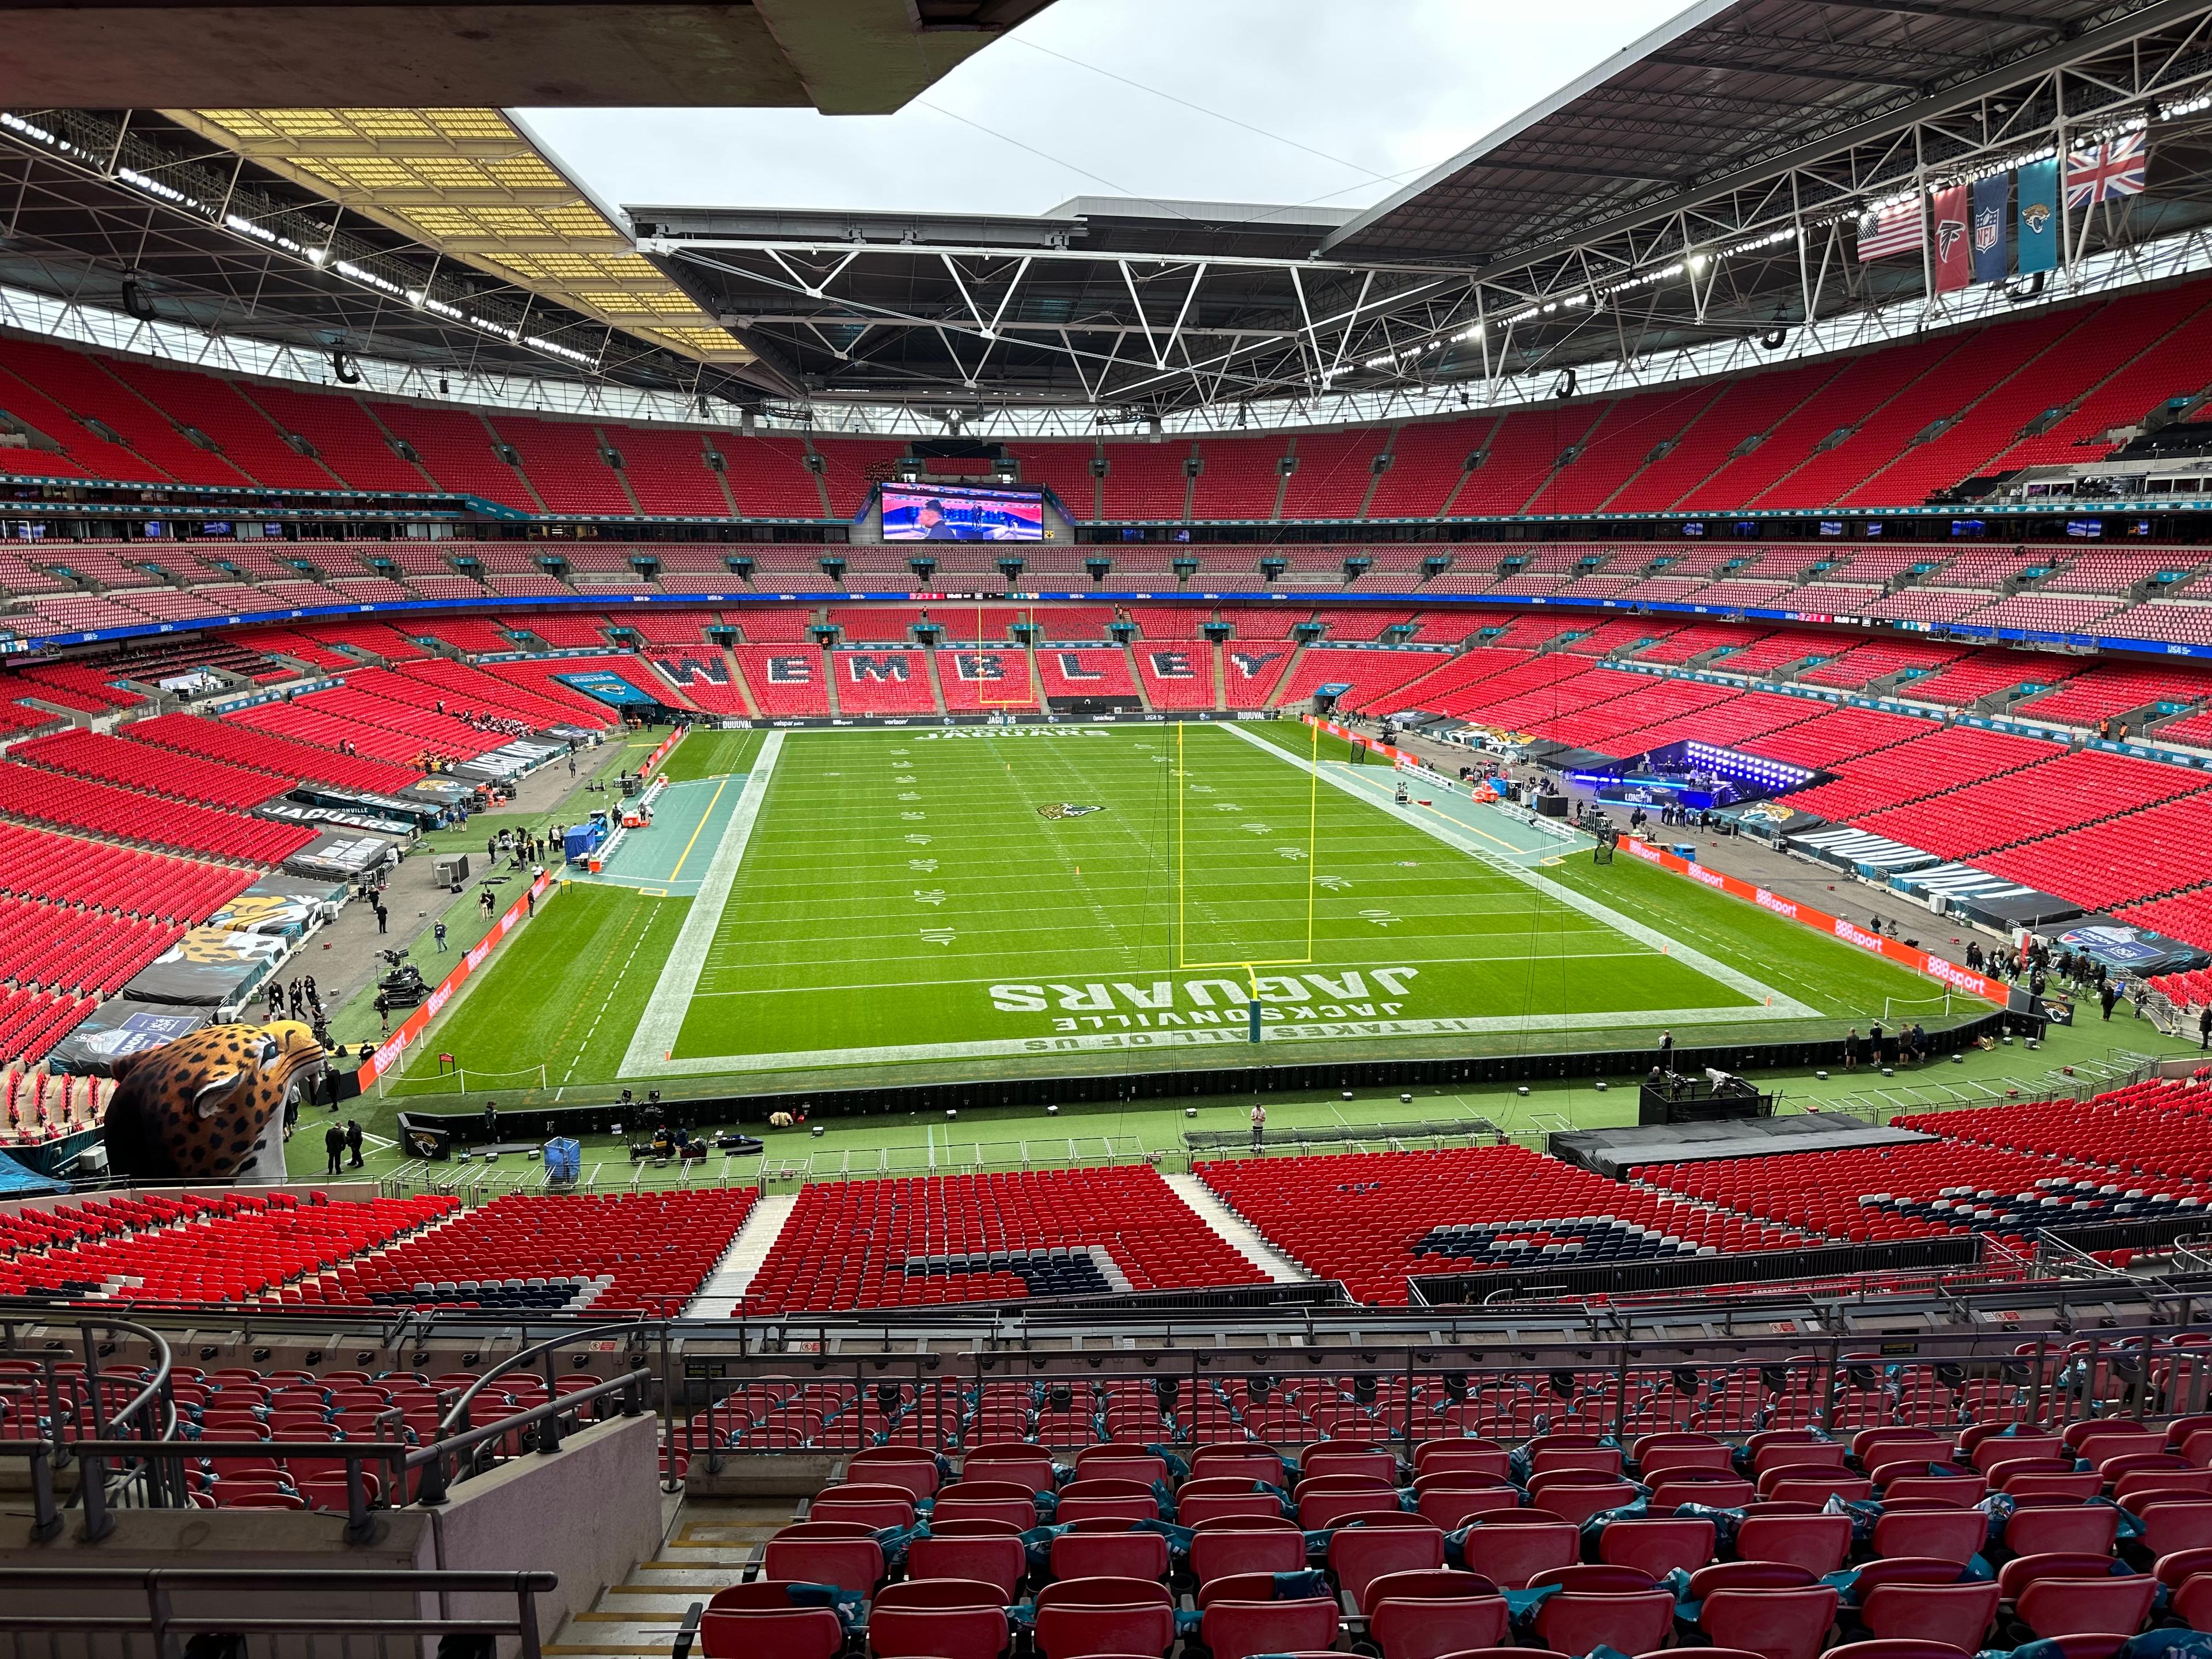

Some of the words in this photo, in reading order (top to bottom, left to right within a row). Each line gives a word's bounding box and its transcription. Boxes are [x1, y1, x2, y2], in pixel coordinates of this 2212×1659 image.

[1977, 226, 1994, 246] NFL
[653, 653, 1285, 689] WEMBLEY
[987, 716, 1016, 724] JAGURS
[1237, 711, 1265, 719] DUUUVAL
[722, 720, 752, 729] DUUUVAL
[914, 730, 1111, 740] JAGUARS
[1624, 793, 1652, 804] LONDN
[262, 808, 404, 831] JAGUARS
[900, 812, 926, 820] 50
[1241, 823, 1272, 832] 40
[904, 834, 932, 843] 40
[1274, 847, 1309, 858] 30
[1630, 839, 1661, 863] 888sport
[908, 859, 938, 870] 30
[1467, 849, 1530, 873] LONDON
[1312, 876, 1353, 888] 20
[1688, 862, 1724, 888] 888sport
[914, 889, 946, 903] 20
[1756, 888, 1797, 918] 888sport
[1358, 910, 1403, 923] 10
[920, 927, 956, 942] 10
[1835, 918, 1883, 952] 888sport
[2076, 929, 2116, 945] LONDON
[467, 940, 489, 972] 888sport
[1927, 956, 1986, 993] 888sport
[988, 967, 1419, 1012] JAGUARS
[427, 980, 452, 1017] 888sport
[1052, 1002, 1404, 1031] JACKSONVILLE
[1272, 1022, 1411, 1037] TAKES
[1431, 1020, 1470, 1031] IT
[1102, 1032, 1154, 1047] OF
[1172, 1027, 1251, 1042] ALL
[374, 1029, 407, 1074] 888sport
[1024, 1039, 1083, 1051] US
